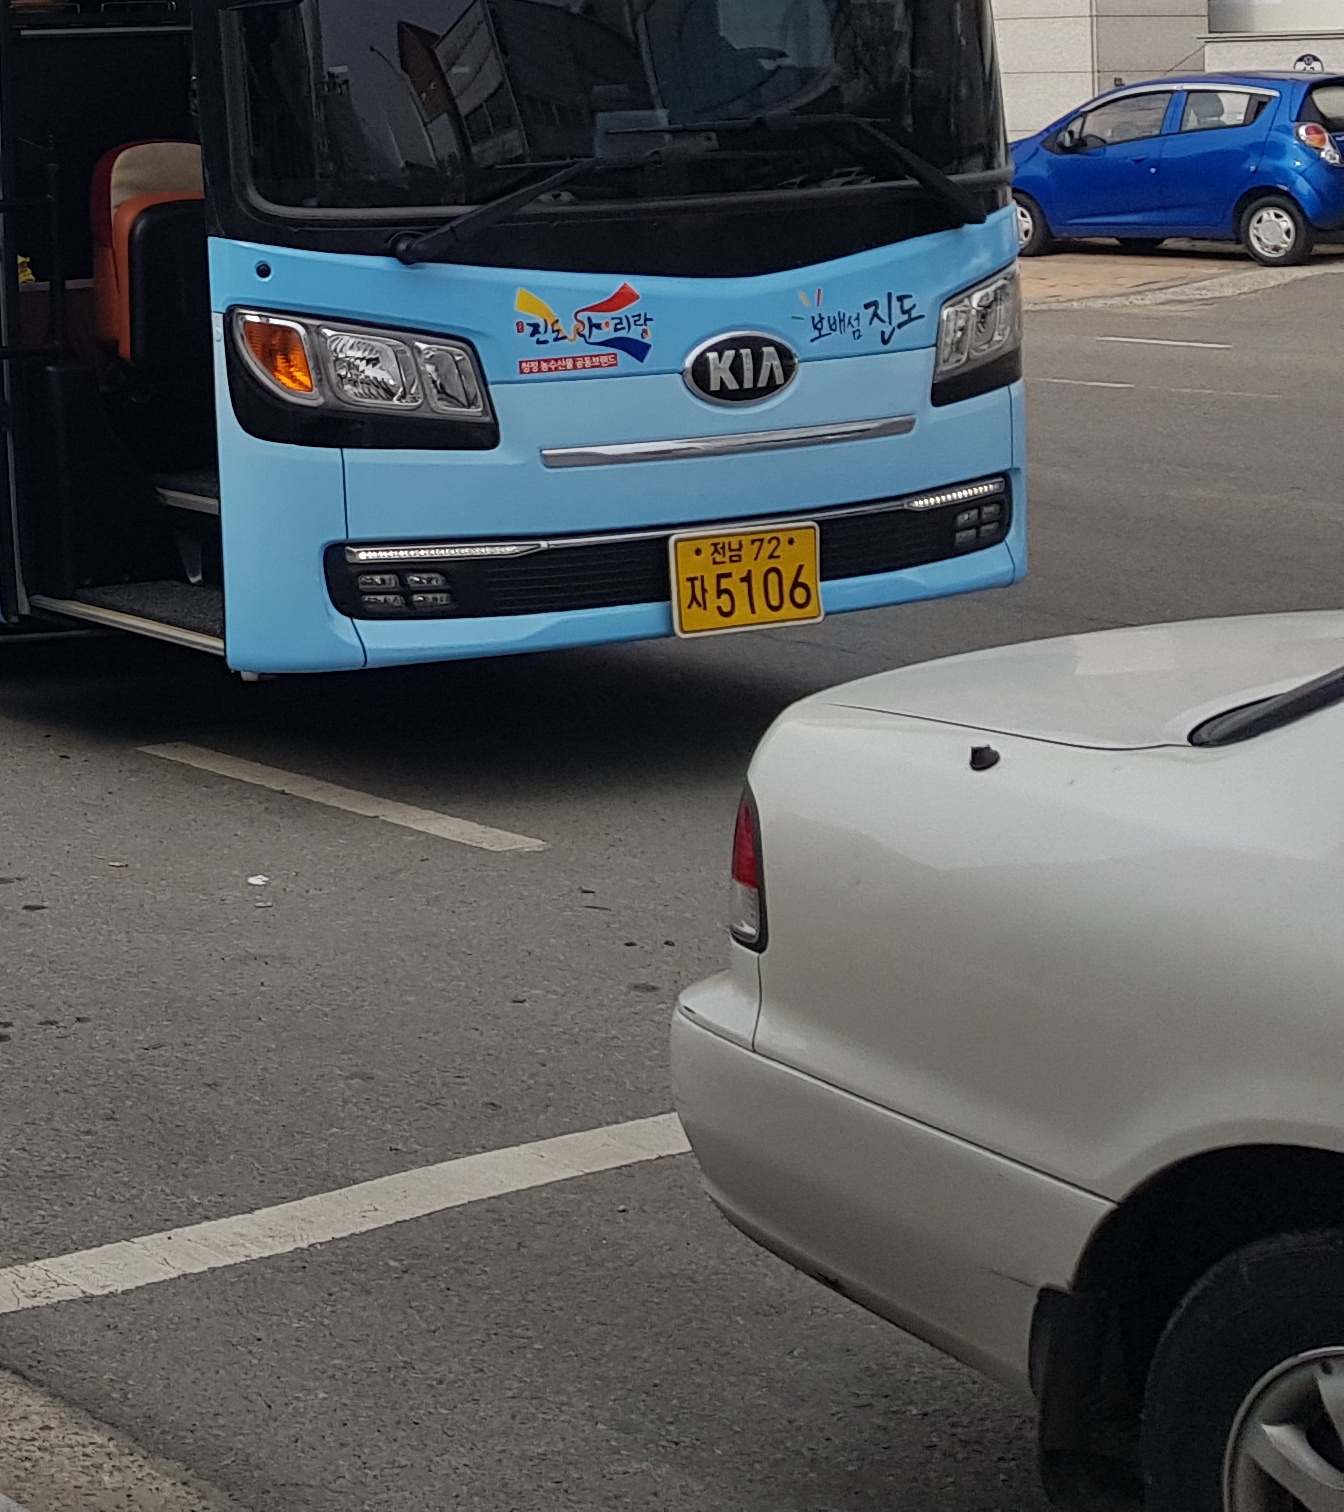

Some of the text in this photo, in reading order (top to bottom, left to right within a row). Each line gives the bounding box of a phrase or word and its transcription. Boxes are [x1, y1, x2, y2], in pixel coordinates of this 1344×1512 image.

[809, 291, 926, 346] 보배섬 진도
[540, 358, 575, 372] 농수산물
[575, 354, 617, 369] 공동브랜드
[705, 347, 785, 391] KIA
[710, 536, 781, 566] 전남 72
